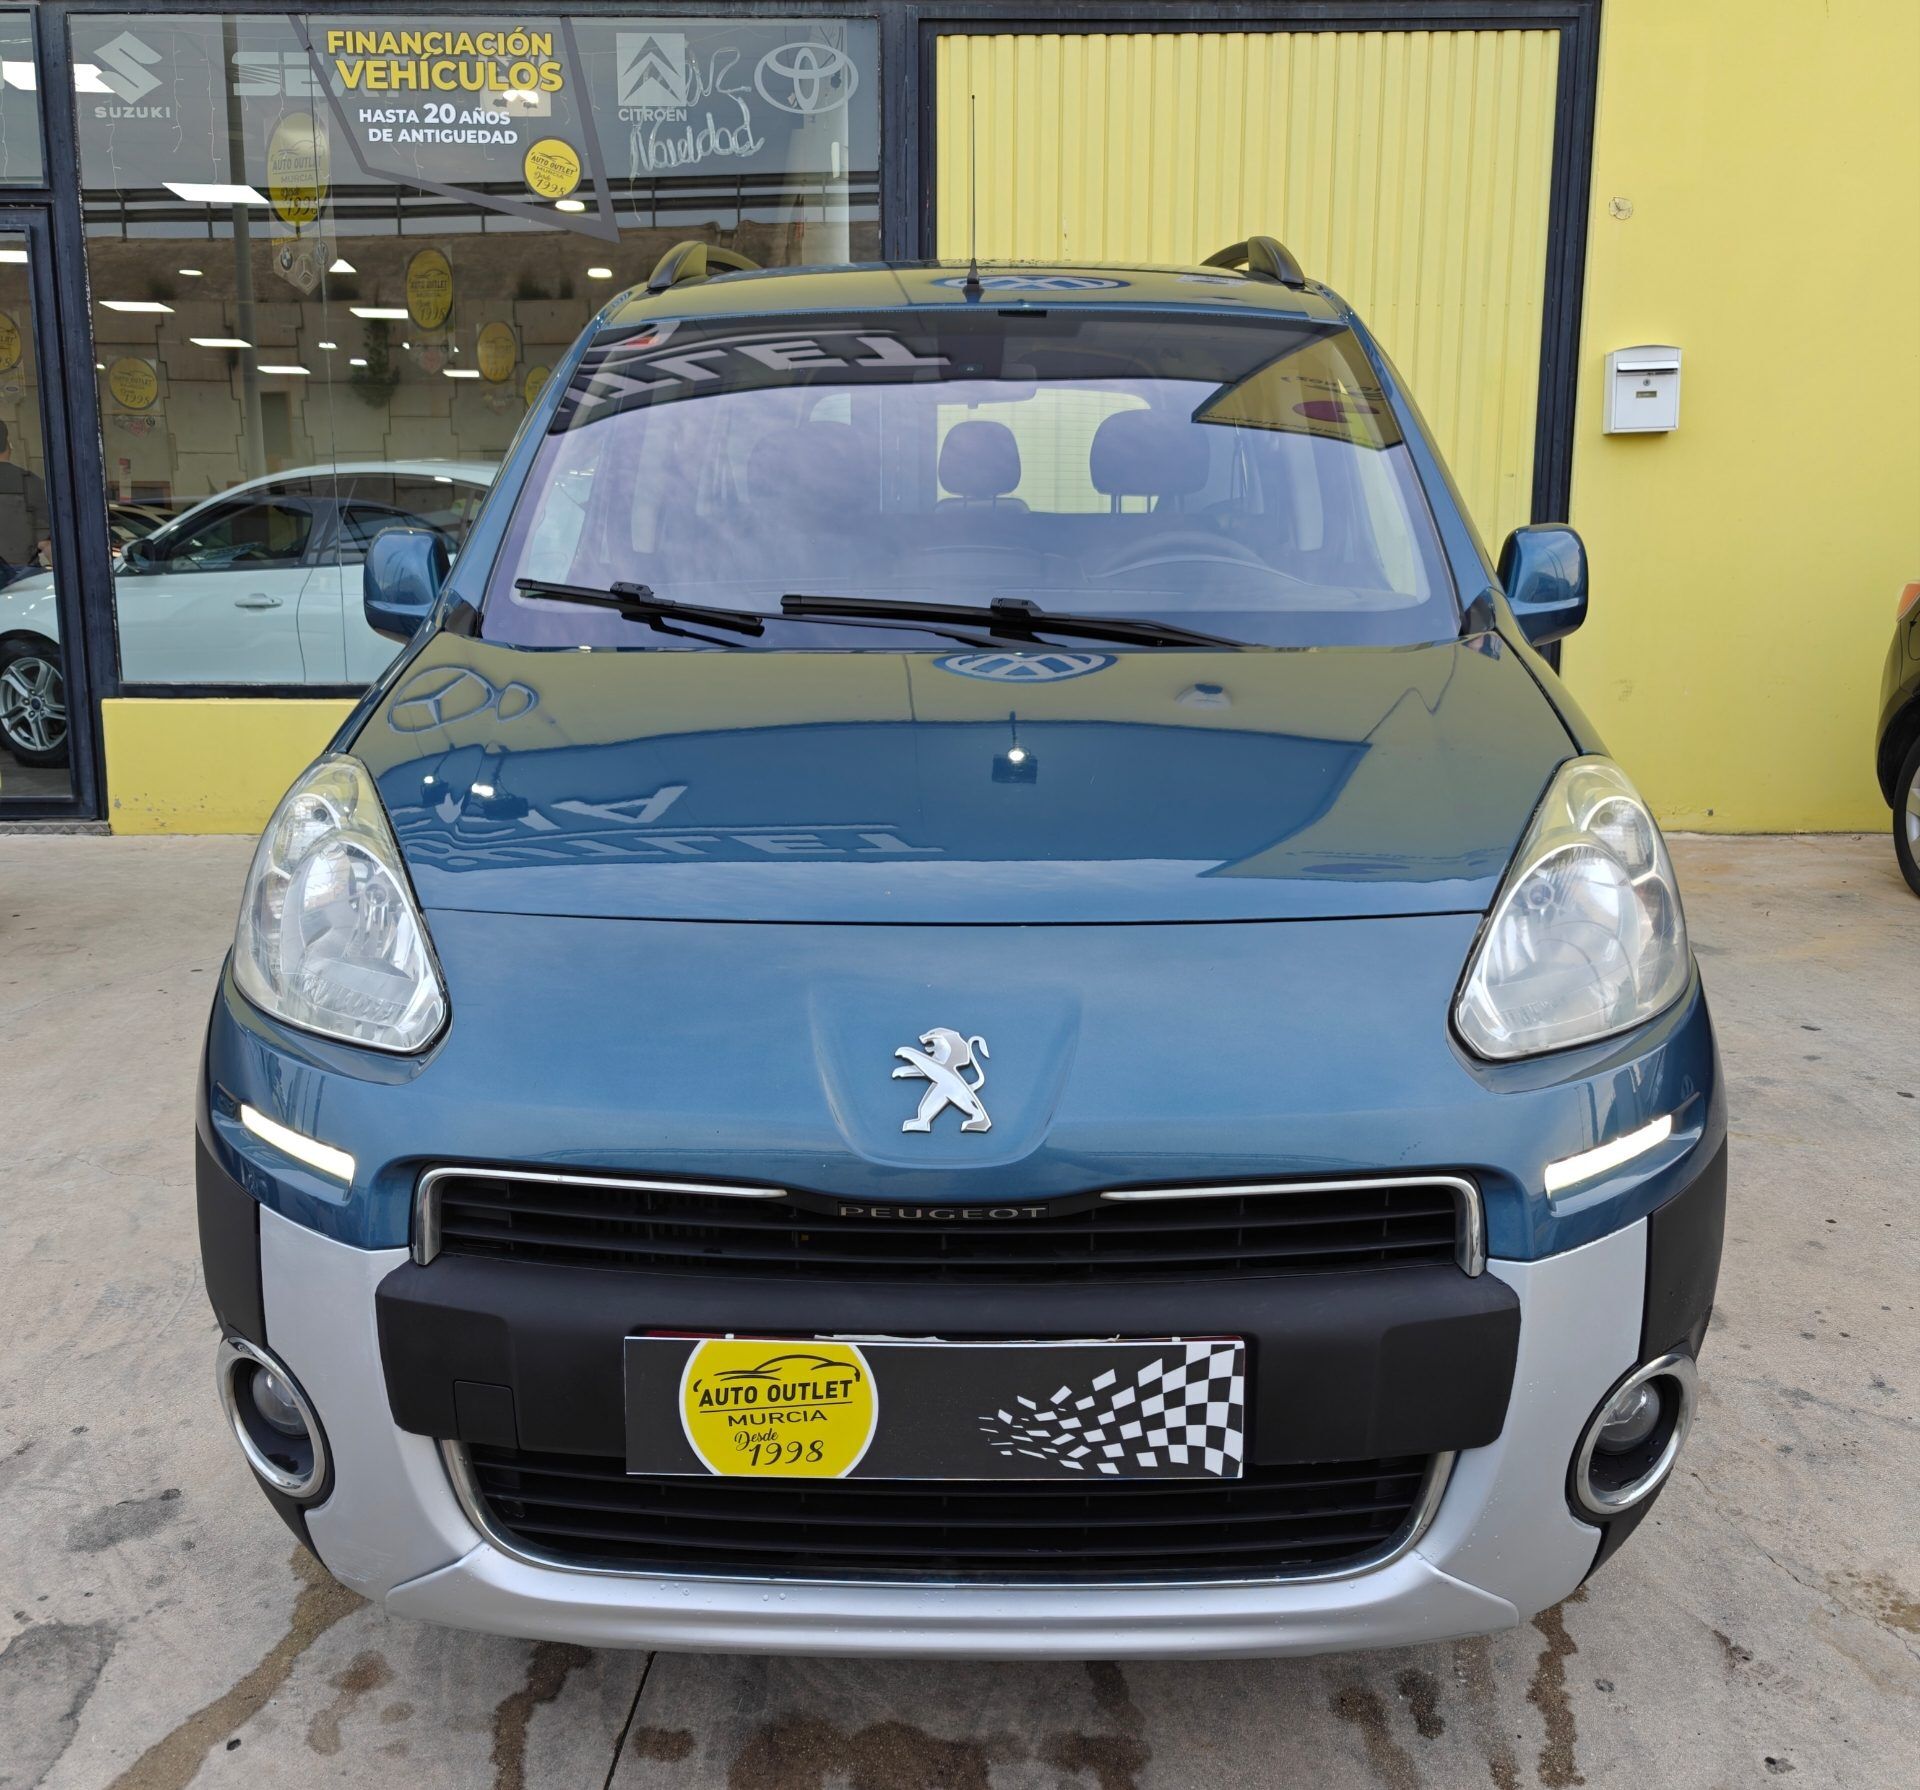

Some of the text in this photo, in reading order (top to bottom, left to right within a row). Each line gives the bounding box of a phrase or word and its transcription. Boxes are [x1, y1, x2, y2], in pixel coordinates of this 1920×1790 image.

[327, 27, 553, 56] FINANCIACIÓN
[335, 53, 564, 91] VEHÍCULOS
[94, 106, 171, 119] SUZUKI
[359, 103, 511, 125] HASTA 20 AÑOS
[368, 129, 518, 144] DE ANTIGUEDAD
[273, 160, 291, 170] AUTO
[532, 156, 574, 175] AUTO OUTLET
[840, 1206, 1047, 1220] PEUGEOT
[698, 1380, 853, 1407] AUTO OUTLET
[728, 1410, 828, 1427] MURCIA
[734, 1428, 779, 1451] Desde
[749, 1440, 824, 1467] 1998
